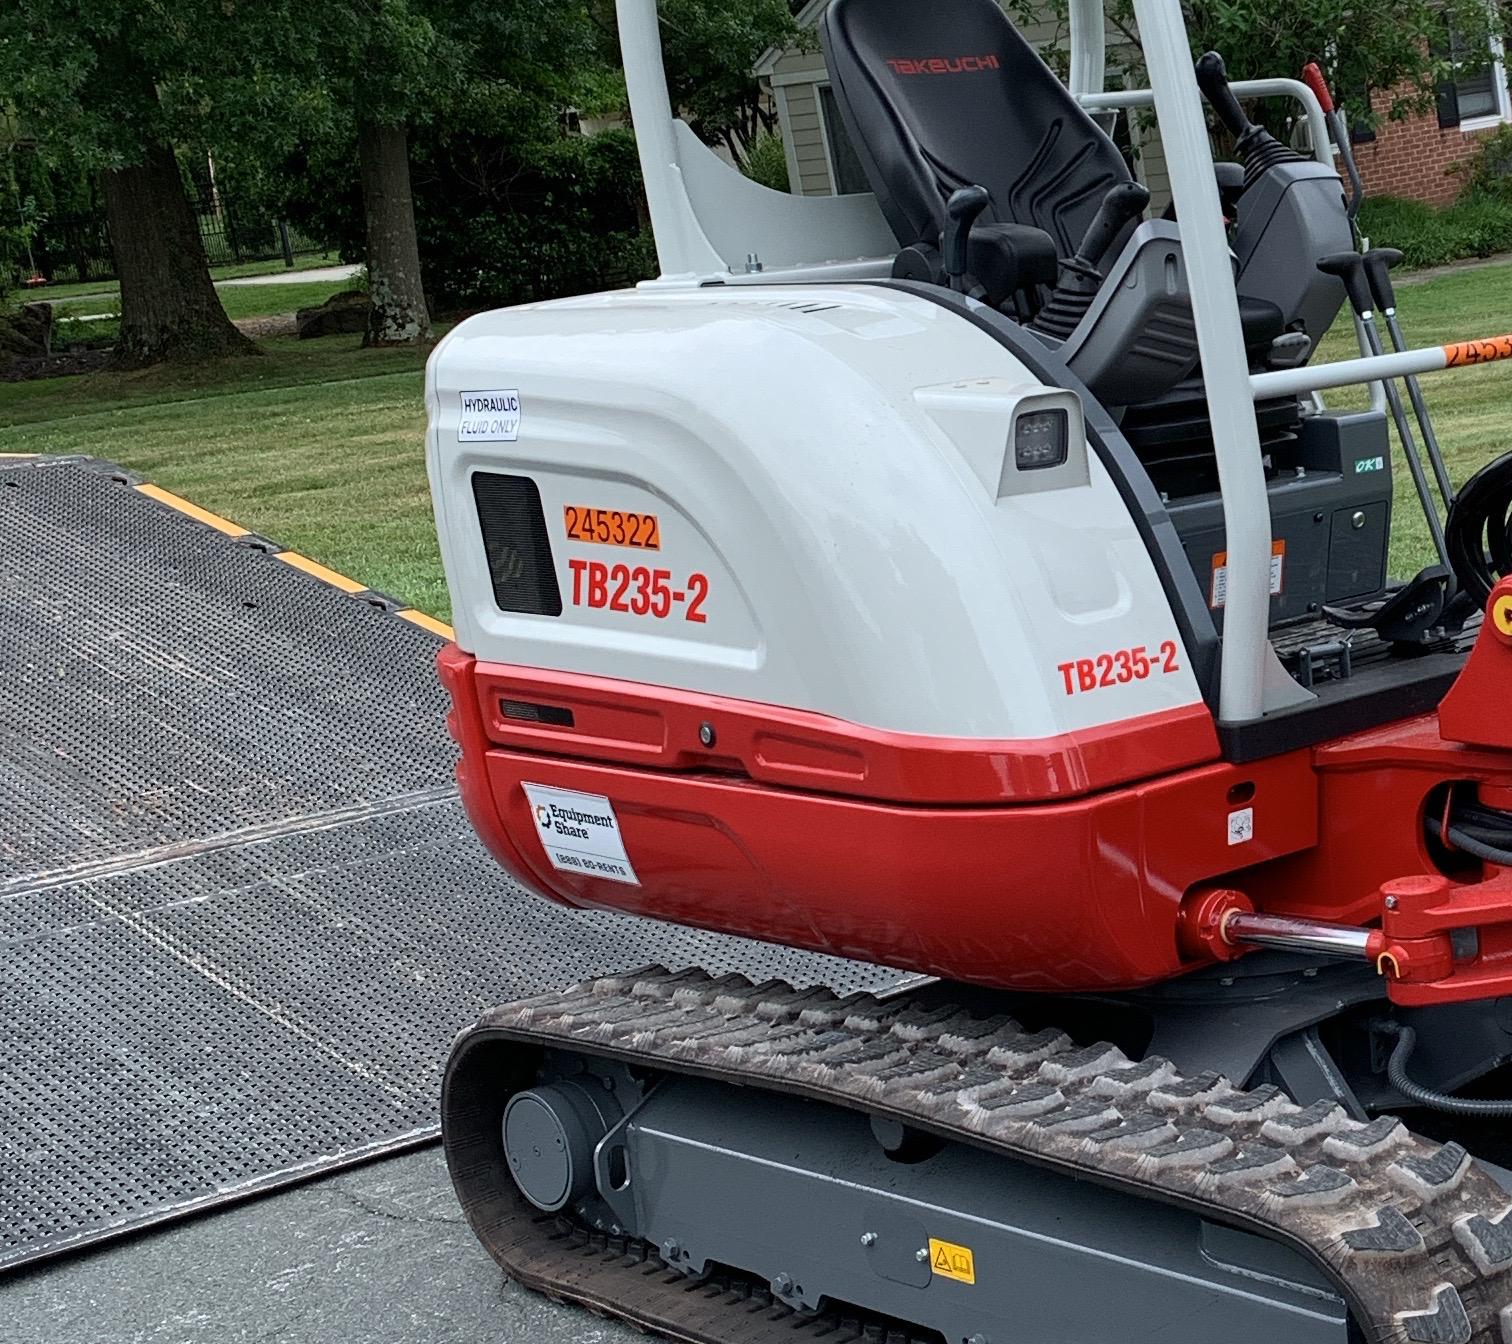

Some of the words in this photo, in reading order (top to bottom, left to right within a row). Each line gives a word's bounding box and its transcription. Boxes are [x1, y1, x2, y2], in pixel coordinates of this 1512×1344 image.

[886, 55, 1000, 75] TAKEUCHI
[464, 397, 518, 412] HYDRAULIC
[461, 420, 488, 434] FLUID
[490, 419, 517, 433] ONLY
[565, 506, 659, 549] 245322
[568, 559, 709, 624] TB235-2
[1057, 640, 1180, 696] TB235-2
[549, 803, 615, 829] Equipment
[554, 820, 590, 839] Share
